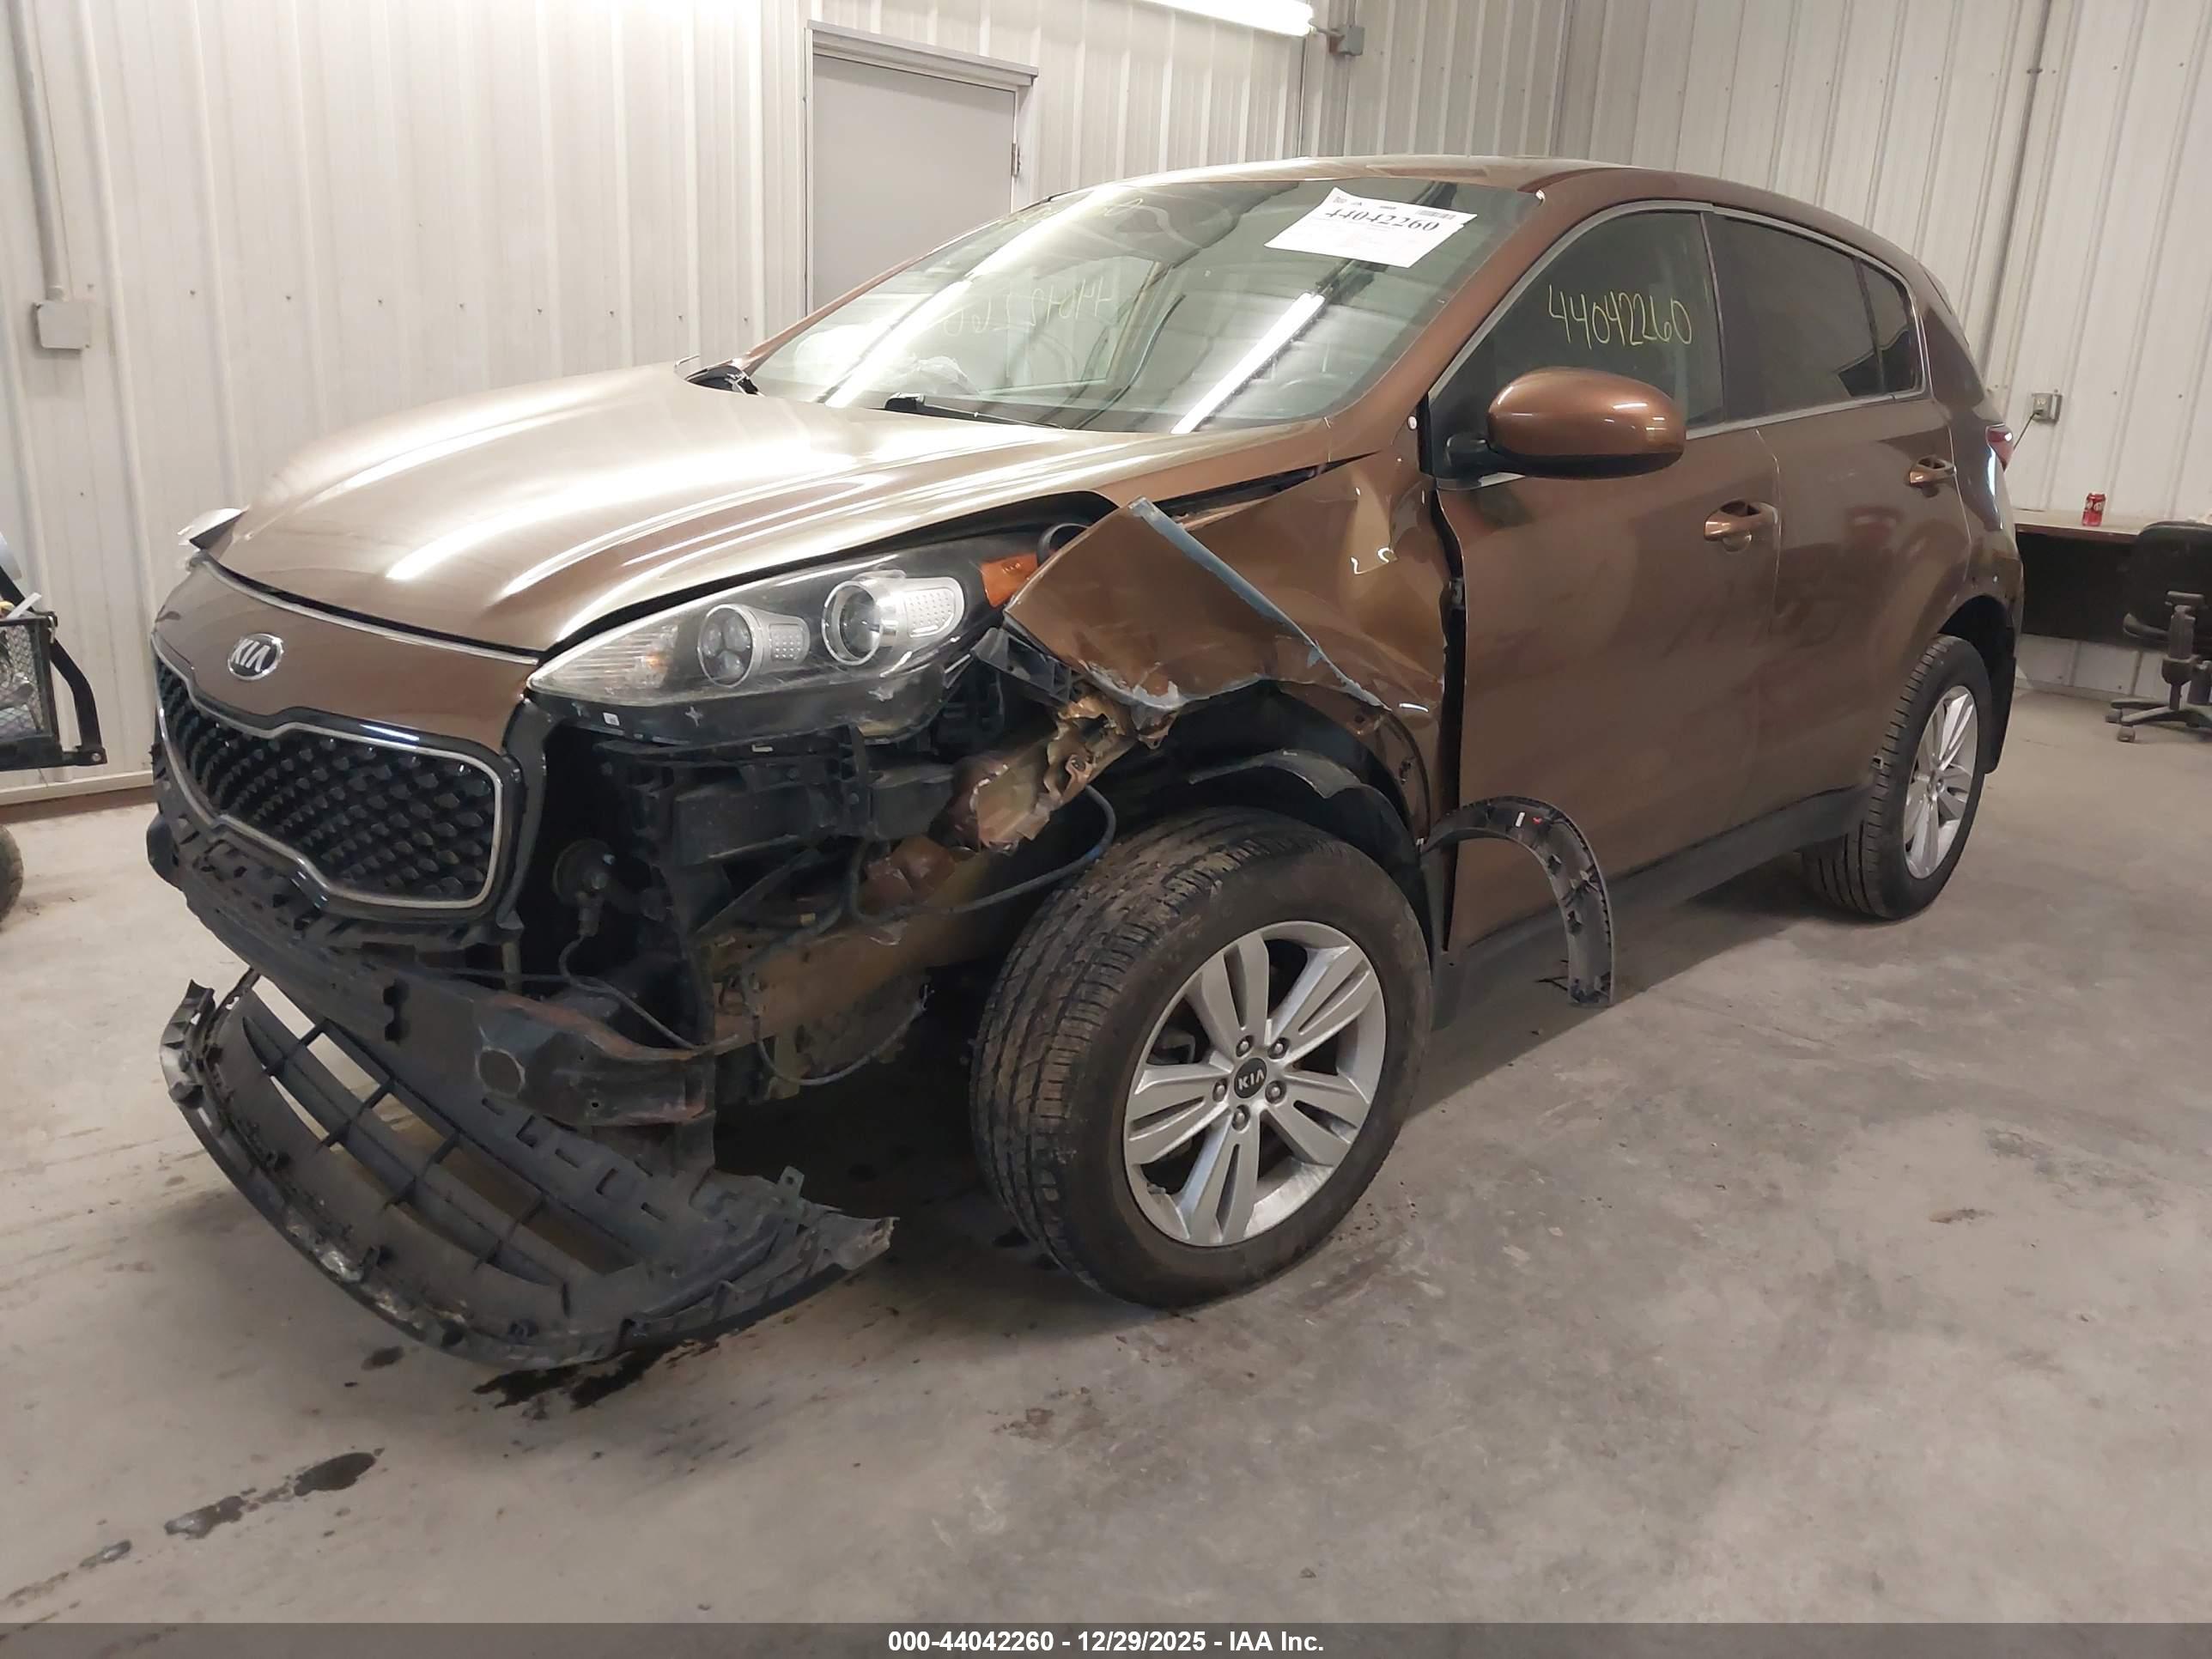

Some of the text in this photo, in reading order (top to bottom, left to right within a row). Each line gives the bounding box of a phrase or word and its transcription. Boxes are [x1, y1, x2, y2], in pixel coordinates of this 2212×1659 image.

[1326, 209, 1440, 231] 44042260
[1548, 284, 1692, 350] 44042260
[230, 638, 270, 672] KIA
[1238, 1069, 1265, 1091] KIA
